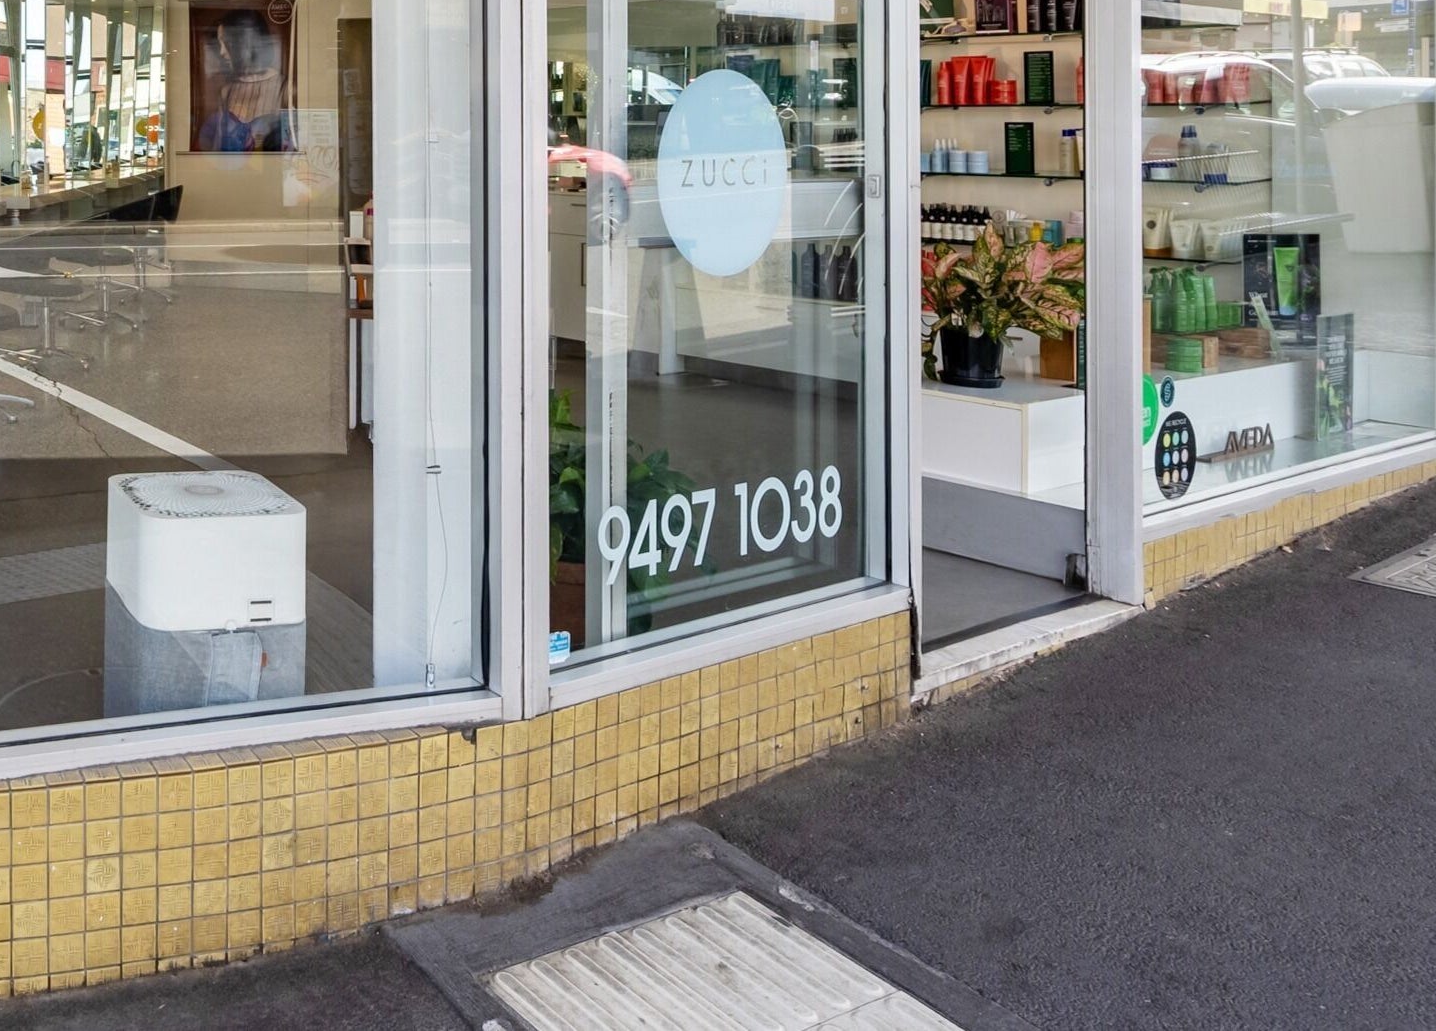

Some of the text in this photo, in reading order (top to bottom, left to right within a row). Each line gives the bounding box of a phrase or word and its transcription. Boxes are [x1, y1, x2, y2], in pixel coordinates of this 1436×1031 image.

[1223, 422, 1275, 455] AVEDA
[597, 464, 843, 586] 9497 1038
